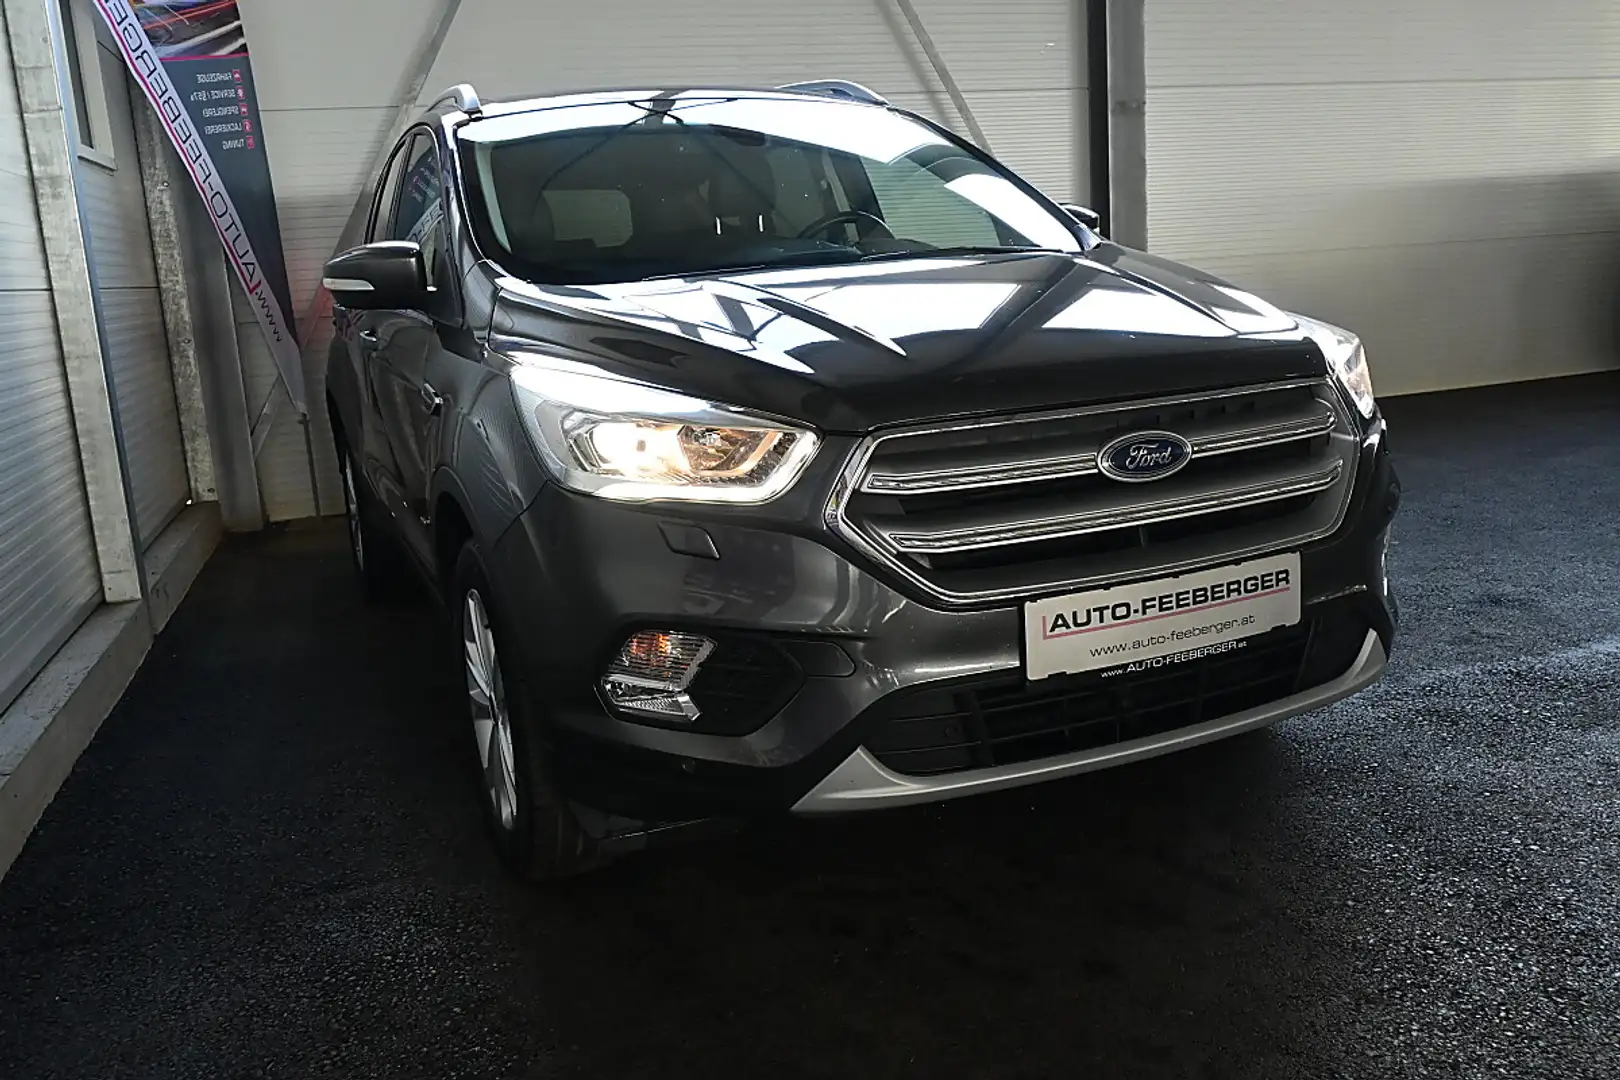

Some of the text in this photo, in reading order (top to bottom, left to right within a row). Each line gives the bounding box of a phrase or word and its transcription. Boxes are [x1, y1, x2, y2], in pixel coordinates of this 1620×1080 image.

[1125, 443, 1171, 469] Ford
[1049, 568, 1290, 633] AUTO-FEEBERGER
[1090, 613, 1256, 657] www.auto-feeberger.at
